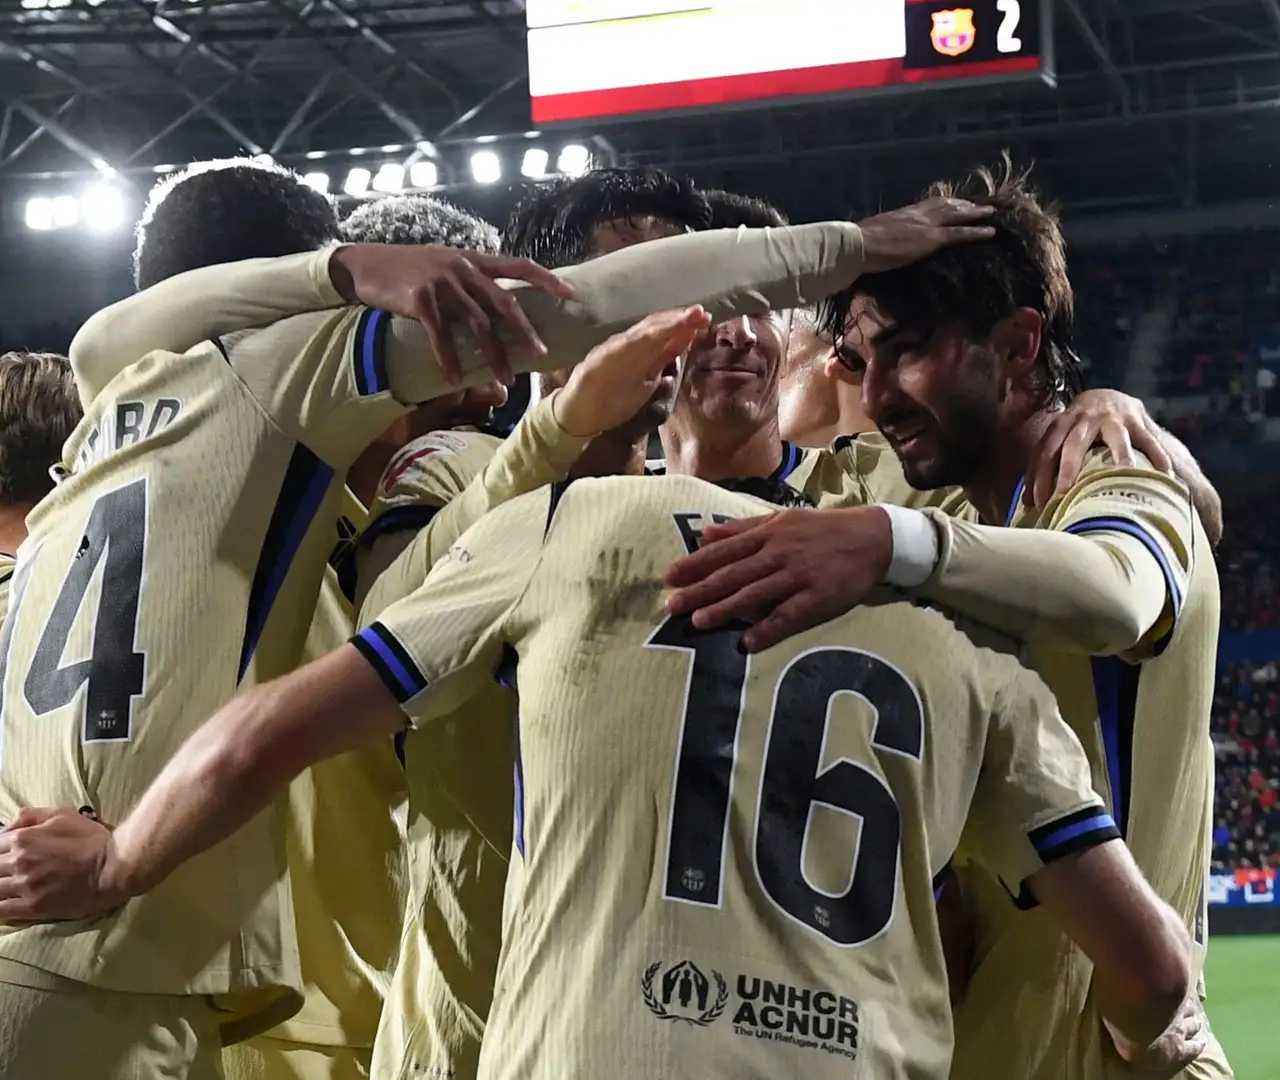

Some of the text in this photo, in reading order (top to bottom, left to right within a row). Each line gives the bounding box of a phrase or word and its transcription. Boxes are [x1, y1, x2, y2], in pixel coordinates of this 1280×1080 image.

[996, 0, 1021, 53] 2
[641, 612, 926, 949] 16
[736, 974, 859, 1023] UNHCR
[732, 1001, 858, 1049] ACNUR
[733, 1025, 857, 1062] The UN Refugee Agency
